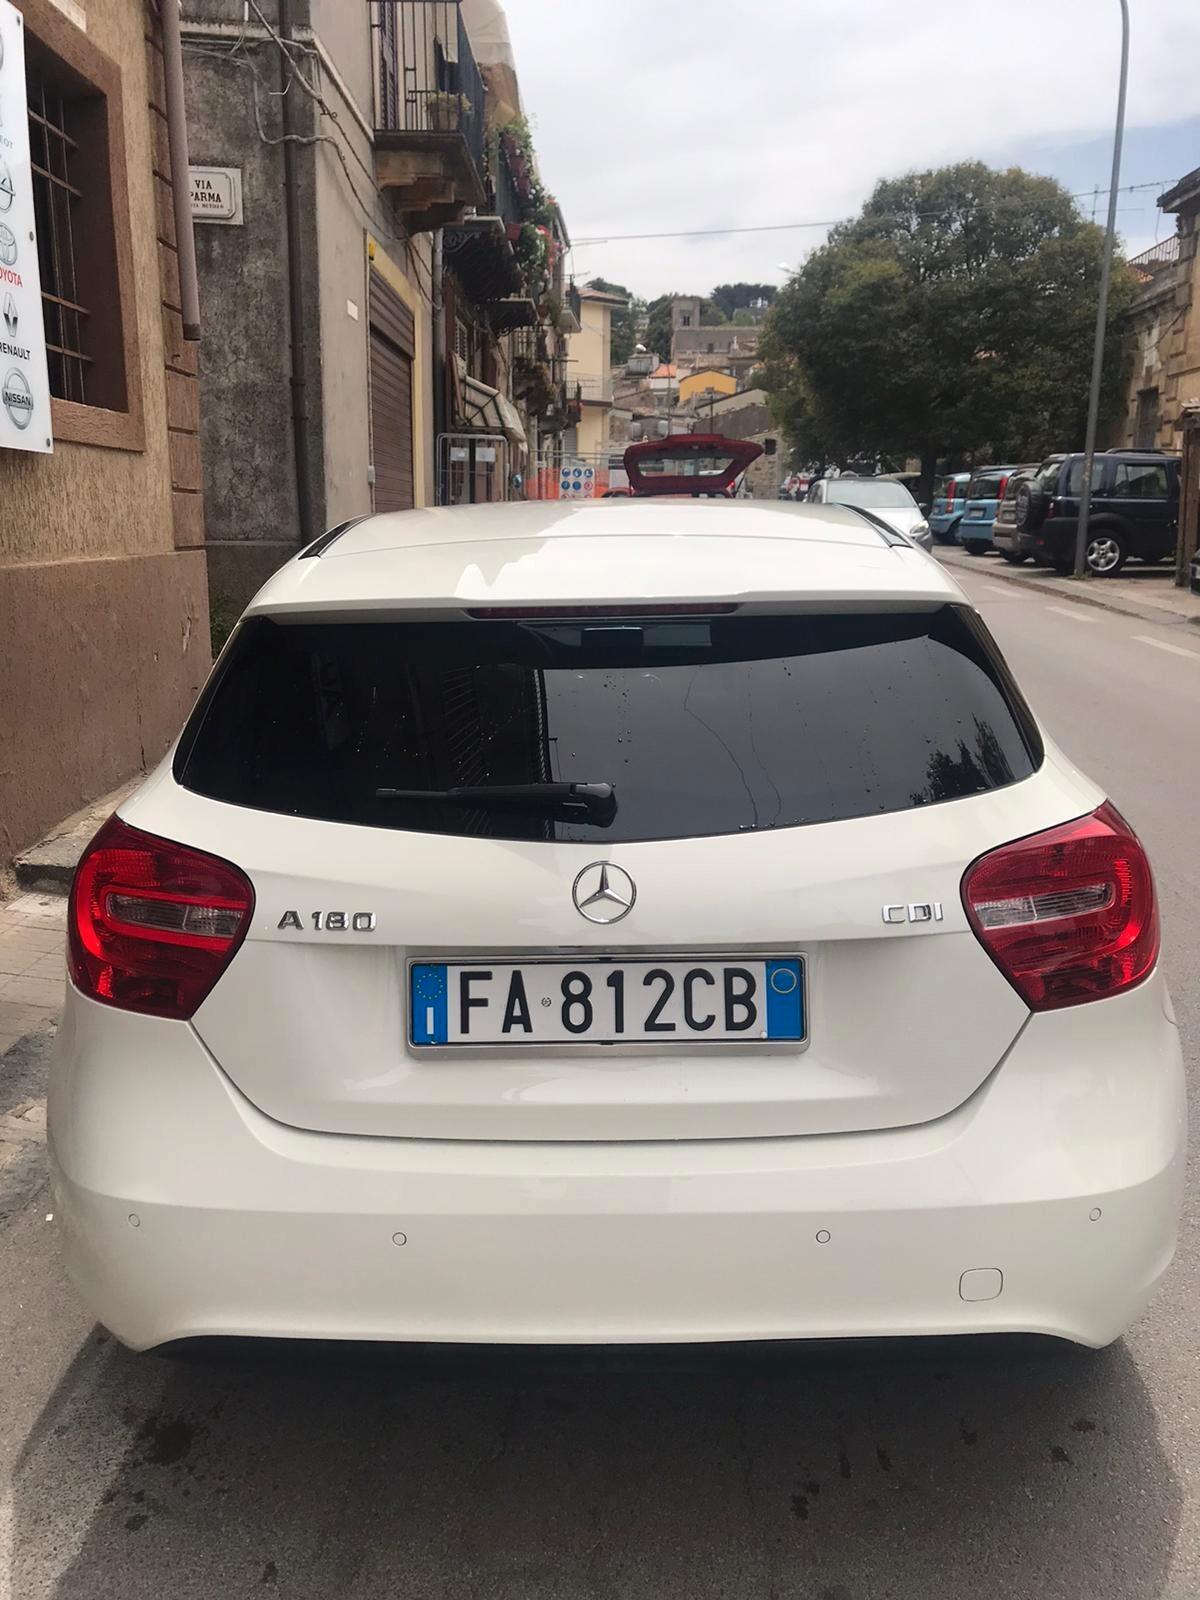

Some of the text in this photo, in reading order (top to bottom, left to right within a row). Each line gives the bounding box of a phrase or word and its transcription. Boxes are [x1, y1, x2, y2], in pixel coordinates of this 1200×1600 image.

[194, 179, 212, 190] VIA
[5, 391, 31, 406] NISSAN
[277, 910, 377, 932] A 180
[881, 903, 943, 923] CDI
[460, 969, 533, 1035] FA
[560, 967, 758, 1035] 812CB
